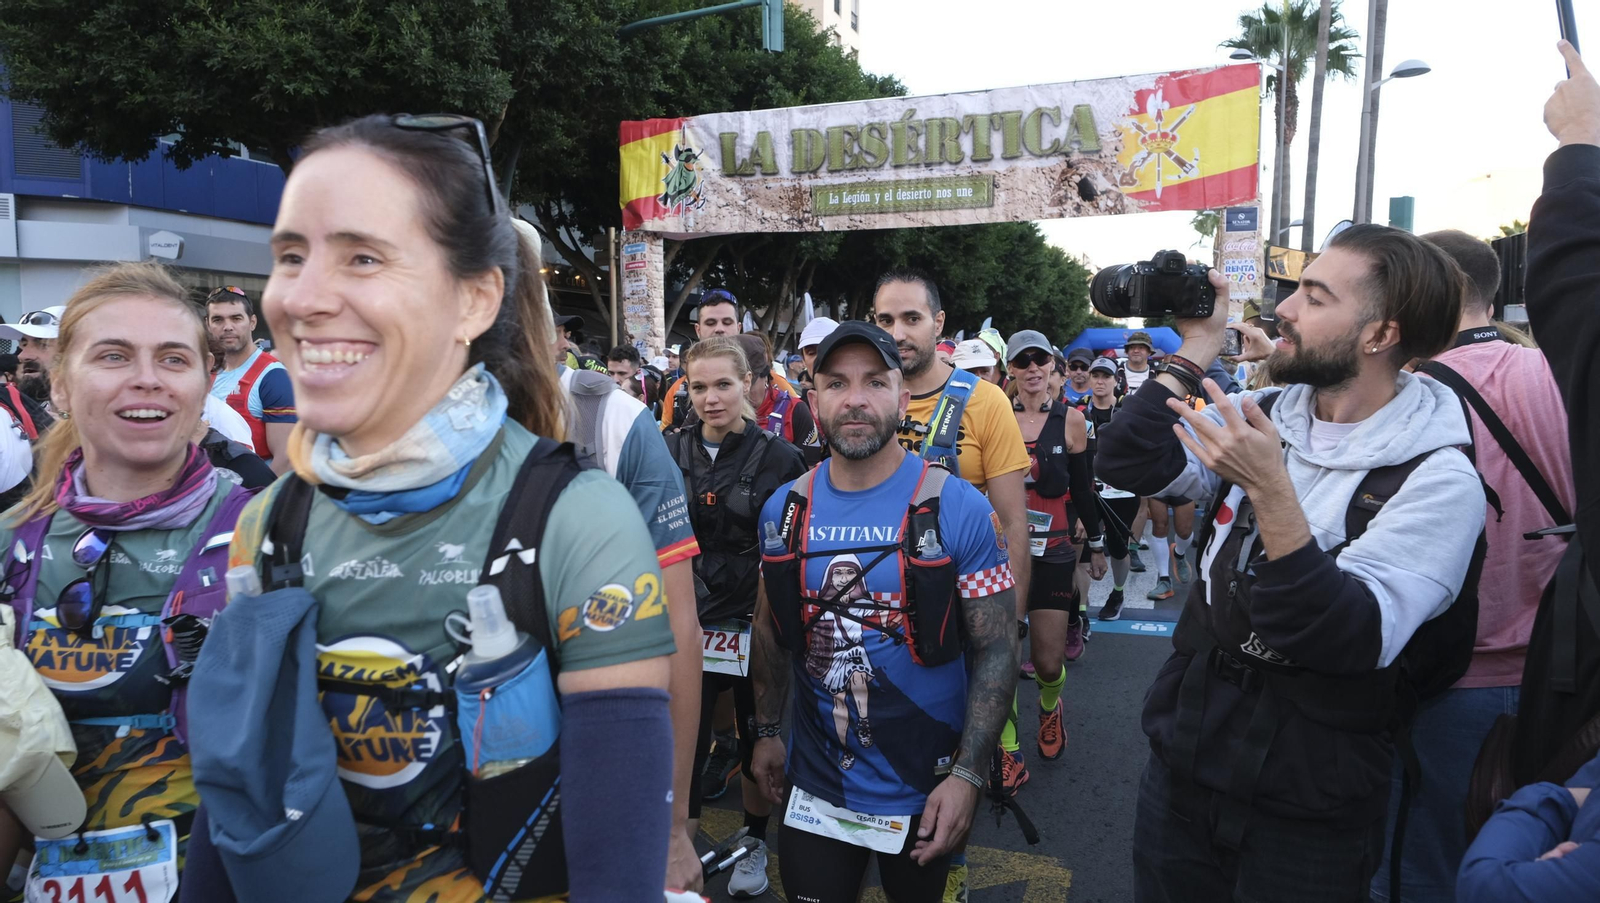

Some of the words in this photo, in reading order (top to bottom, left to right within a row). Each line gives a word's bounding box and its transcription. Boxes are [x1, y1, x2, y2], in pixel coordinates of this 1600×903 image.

[718, 130, 780, 176] LA
[790, 103, 1102, 174] DESÉRTICA
[829, 192, 839, 204] La
[842, 190, 870, 206] Legión
[874, 192, 881, 204] y
[884, 188, 893, 201] el
[896, 187, 932, 201] desierto
[936, 186, 952, 198] nos
[956, 185, 973, 197] une
[1225, 265, 1255, 273] RENTA
[1473, 331, 1498, 340] SONY
[657, 503, 667, 513] LA
[657, 514, 669, 524] EL
[668, 504, 688, 519] DESI
[668, 518, 684, 531] NOS
[798, 804, 811, 813] BUS
[856, 814, 876, 824] CESAR
[43, 869, 149, 903] 3111
